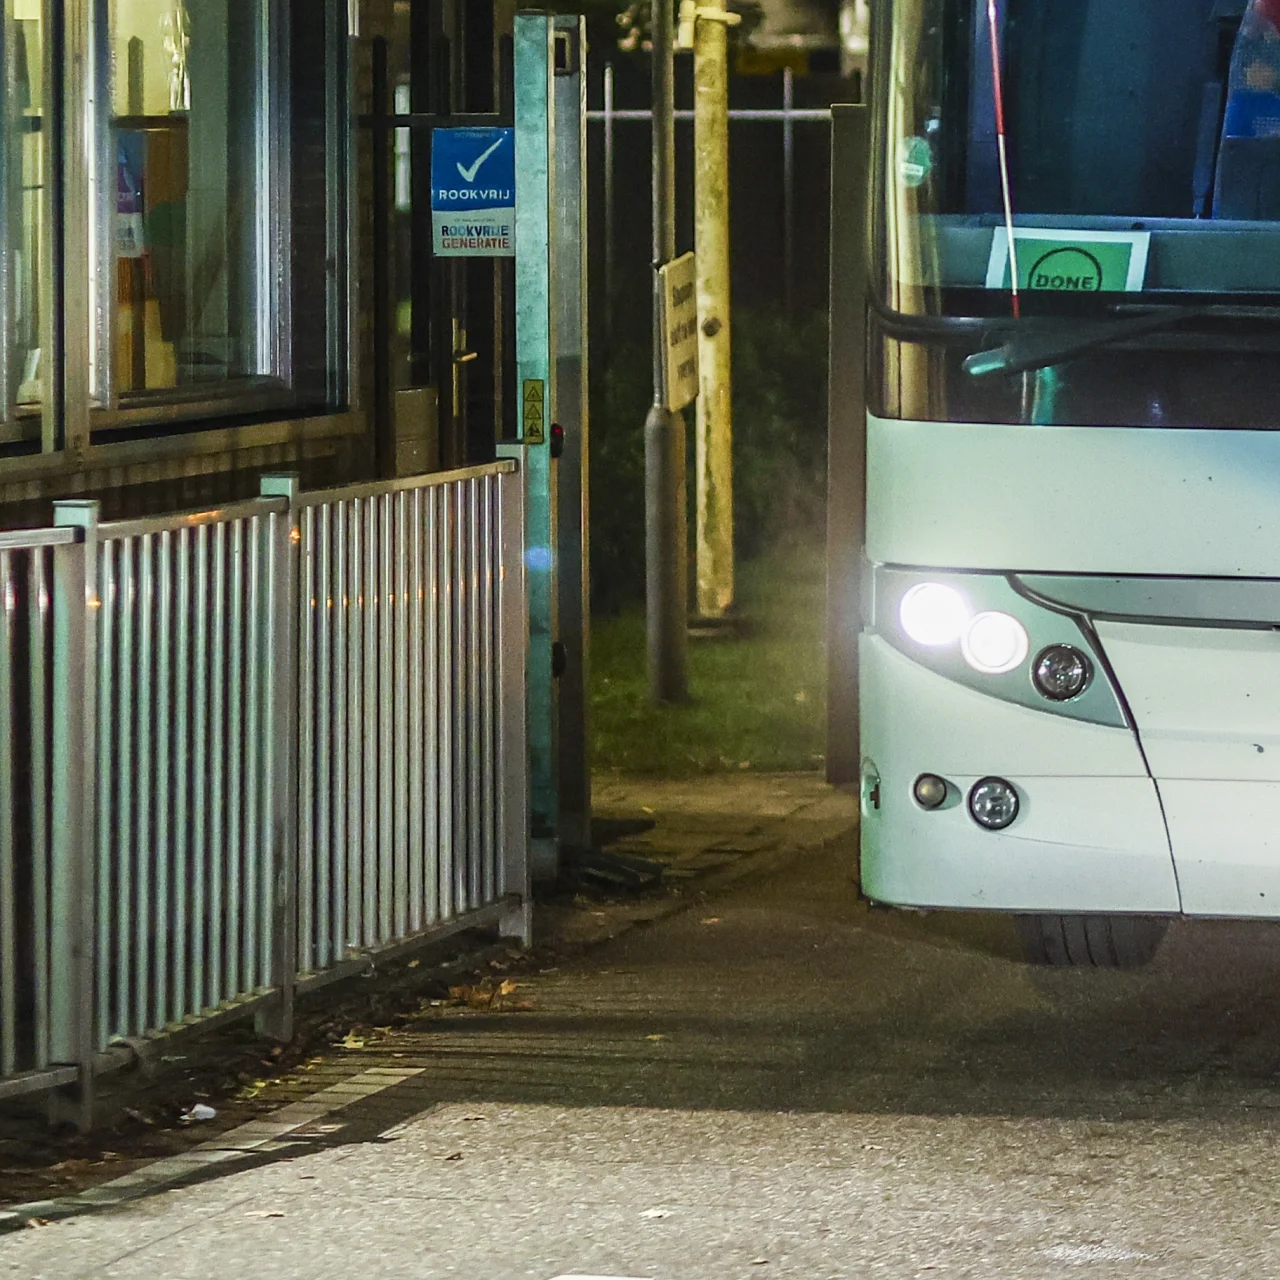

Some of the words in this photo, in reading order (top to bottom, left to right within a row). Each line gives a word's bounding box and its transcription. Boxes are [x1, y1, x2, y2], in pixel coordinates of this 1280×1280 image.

[439, 189, 510, 200] ROOKVRIJ
[441, 225, 509, 237] ROOKVRIJE
[442, 237, 510, 249] GENERATIE
[1036, 273, 1094, 290] DONE
